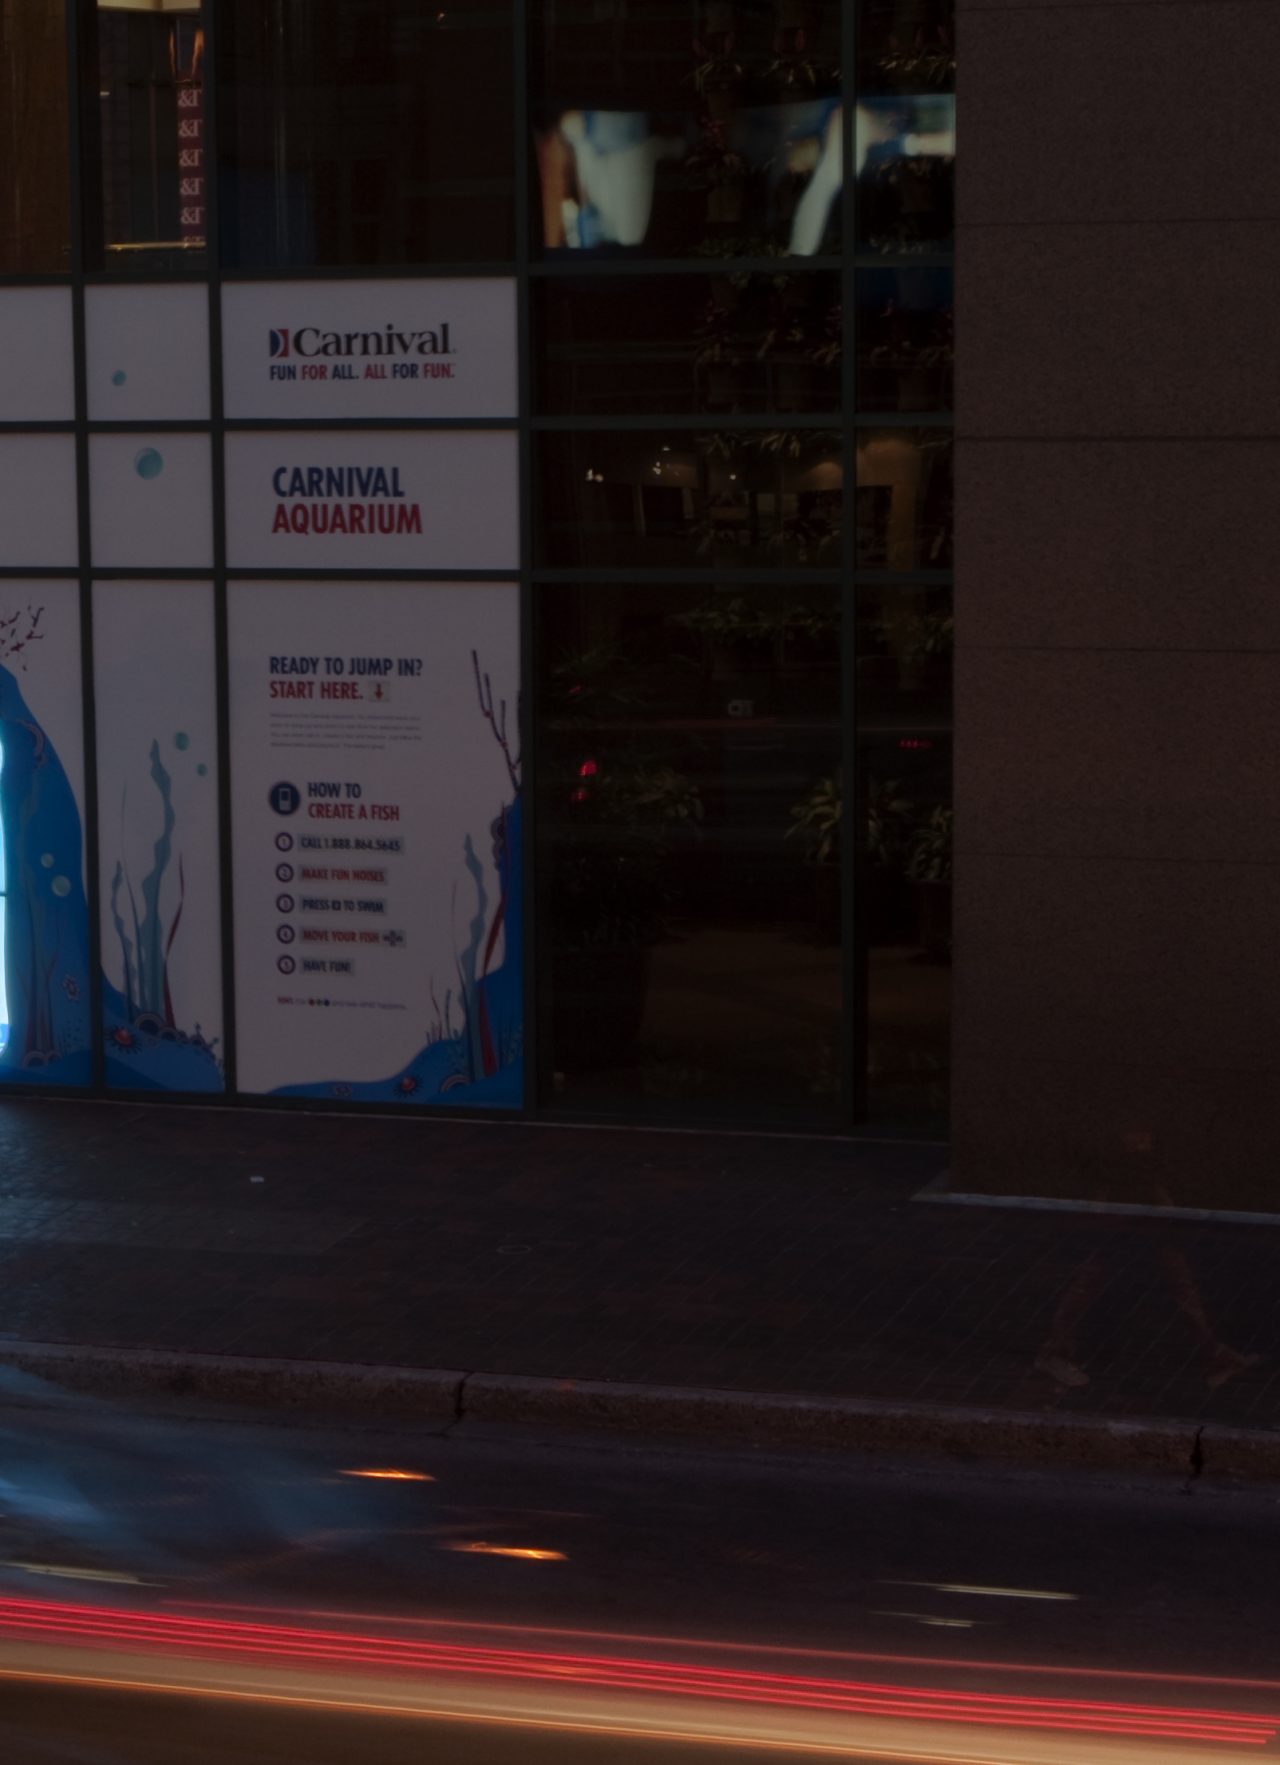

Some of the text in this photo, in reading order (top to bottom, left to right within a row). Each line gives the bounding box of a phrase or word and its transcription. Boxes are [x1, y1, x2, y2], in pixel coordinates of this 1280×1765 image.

[293, 323, 449, 357] Carnival
[270, 365, 296, 380] FUN
[301, 365, 328, 380] FOR
[332, 364, 359, 379] ALL.
[364, 364, 387, 379] ALL
[393, 364, 419, 379] FOR
[272, 466, 404, 497] CARNIVAL
[272, 504, 422, 534] AQUARIUM
[270, 657, 423, 676] READY TO JUMP IN?
[270, 681, 363, 699] START HERE.
[308, 782, 361, 798] HOW TO
[308, 804, 399, 820] CREATE A FISH
[301, 837, 321, 848] CALL
[302, 868, 328, 880] MAKE
[331, 870, 349, 880] FUN
[353, 870, 385, 882] NOISES
[302, 899, 329, 910] PRESS
[343, 900, 354, 911] TO
[357, 901, 384, 912] SWIM
[303, 931, 329, 941] MOVE
[332, 931, 356, 942] YOUR
[360, 932, 380, 943] FISH
[303, 961, 326, 972] HAVE
